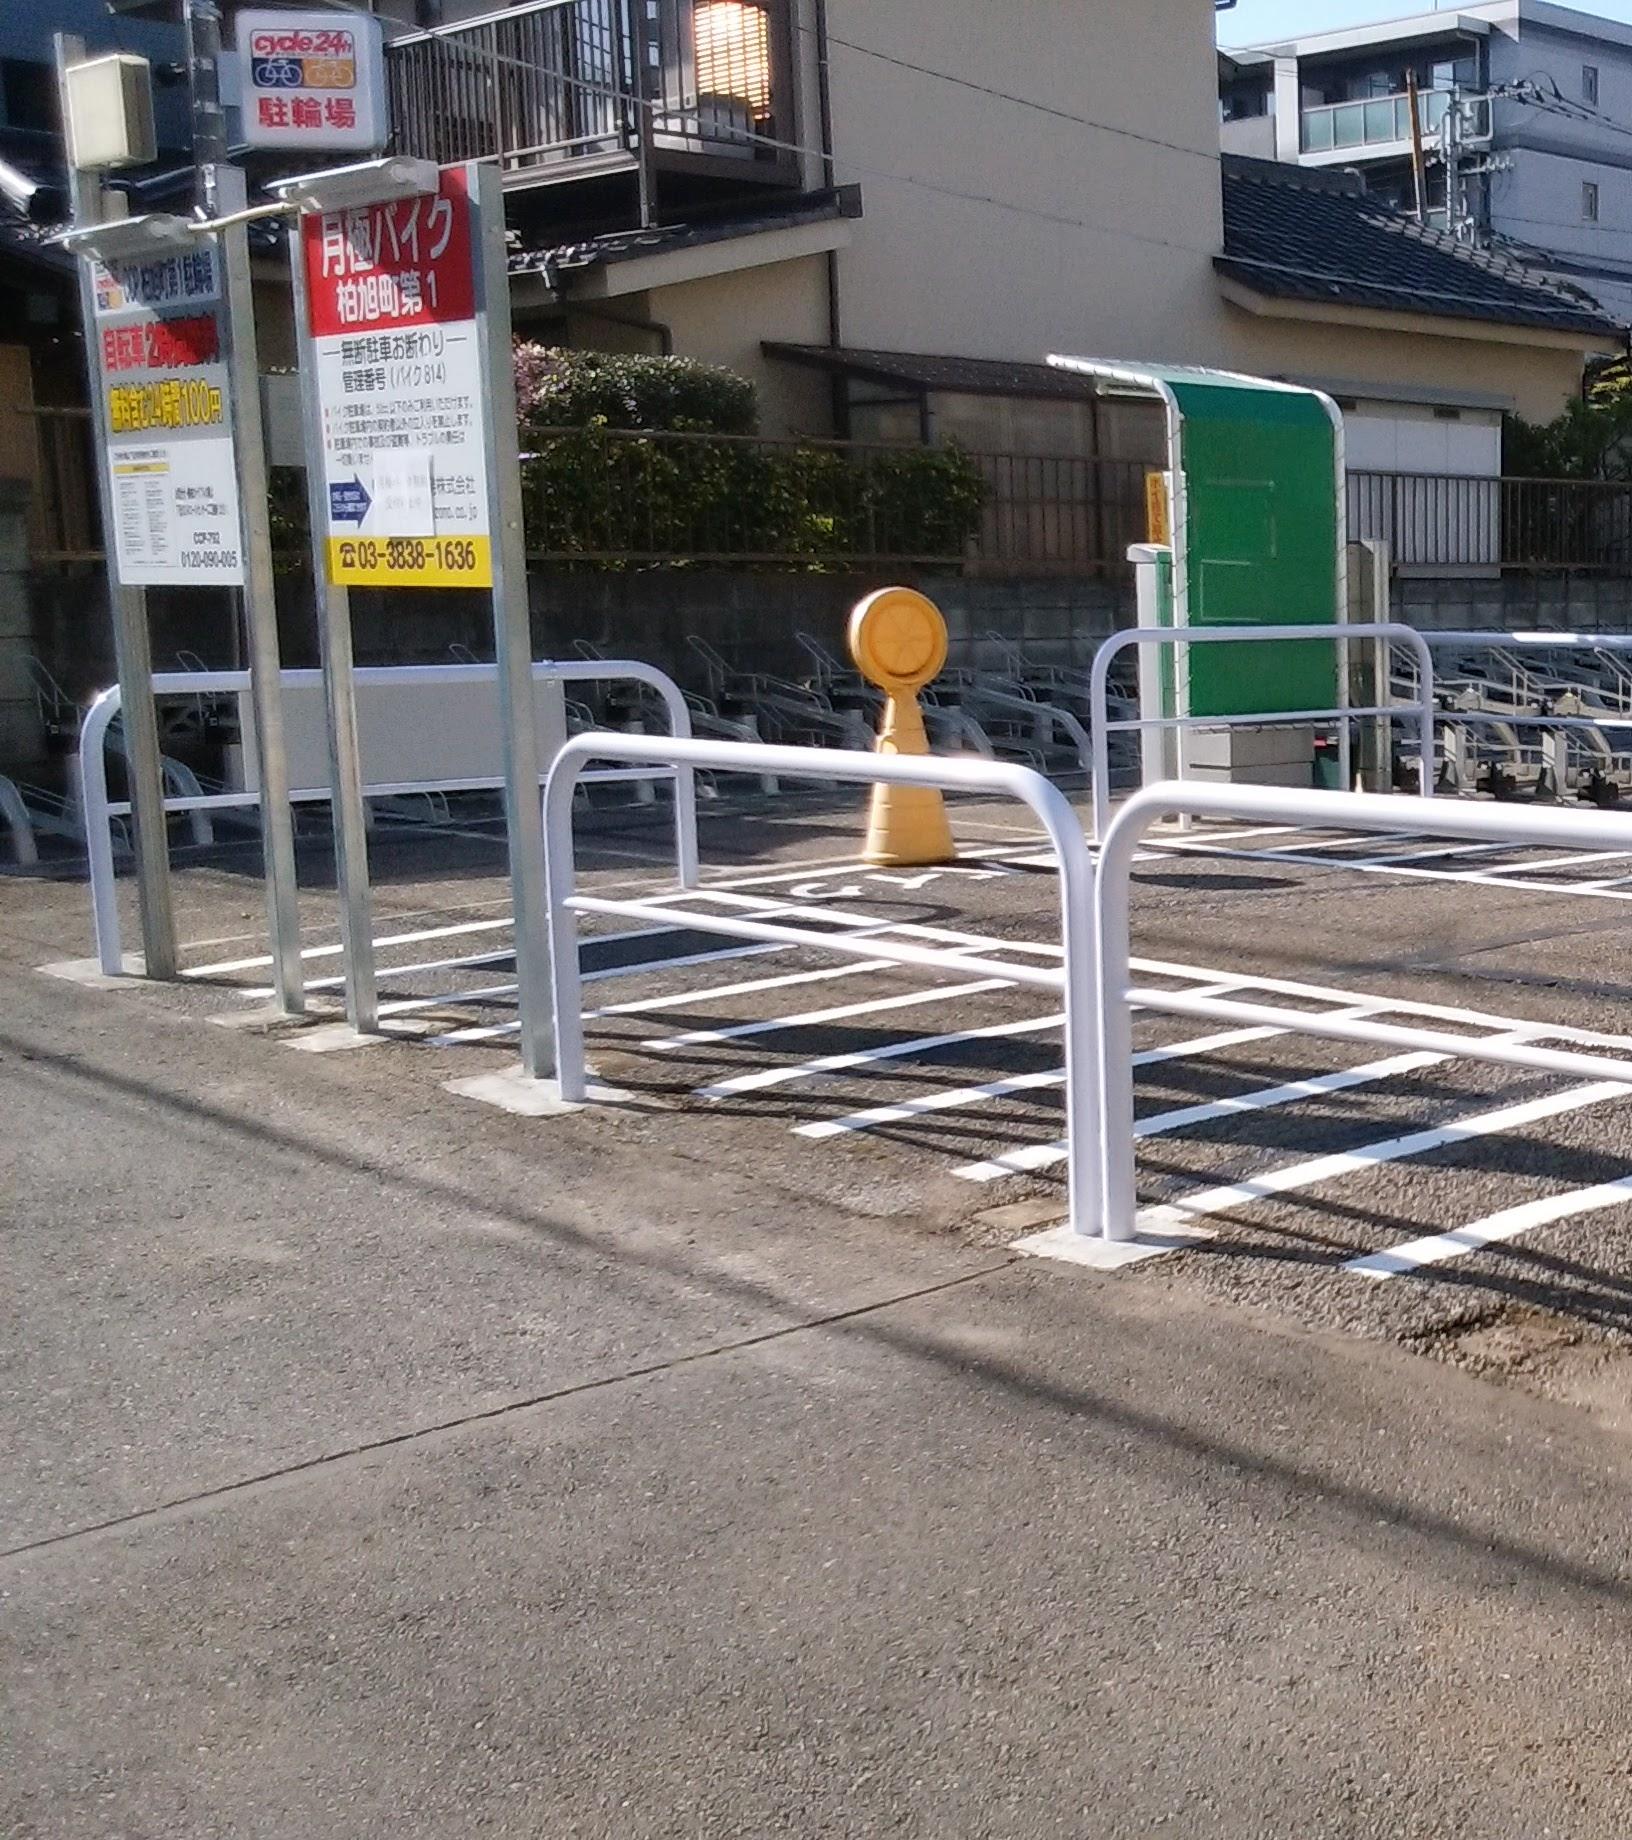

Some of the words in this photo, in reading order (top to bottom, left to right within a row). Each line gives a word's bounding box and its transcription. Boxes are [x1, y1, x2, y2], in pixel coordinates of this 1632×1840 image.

[258, 96, 356, 129] 駐輪場
[321, 195, 453, 278] 月極バイク
[357, 540, 476, 571] 03-3838-1636
